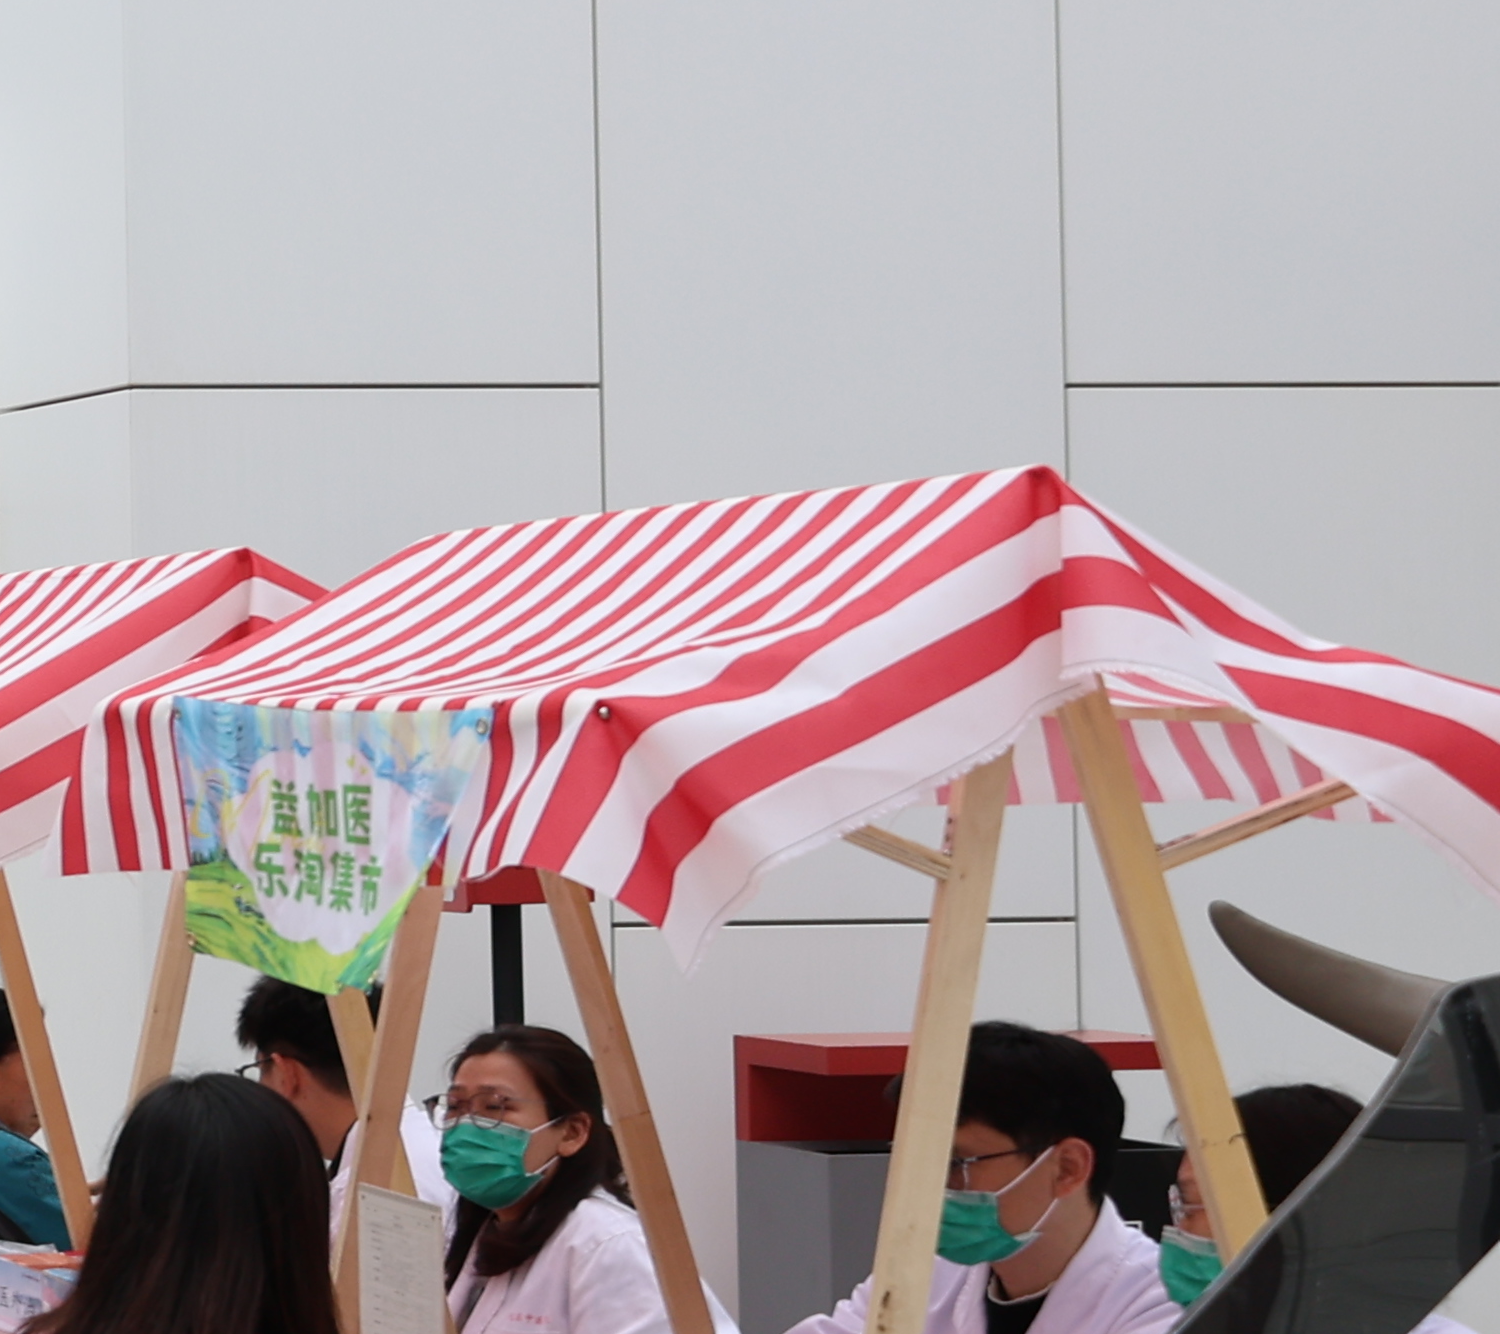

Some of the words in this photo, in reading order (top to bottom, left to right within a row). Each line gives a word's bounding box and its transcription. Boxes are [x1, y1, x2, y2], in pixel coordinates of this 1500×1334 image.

[270, 779, 373, 846] 益加医
[253, 842, 383, 917] 乐淘集市
